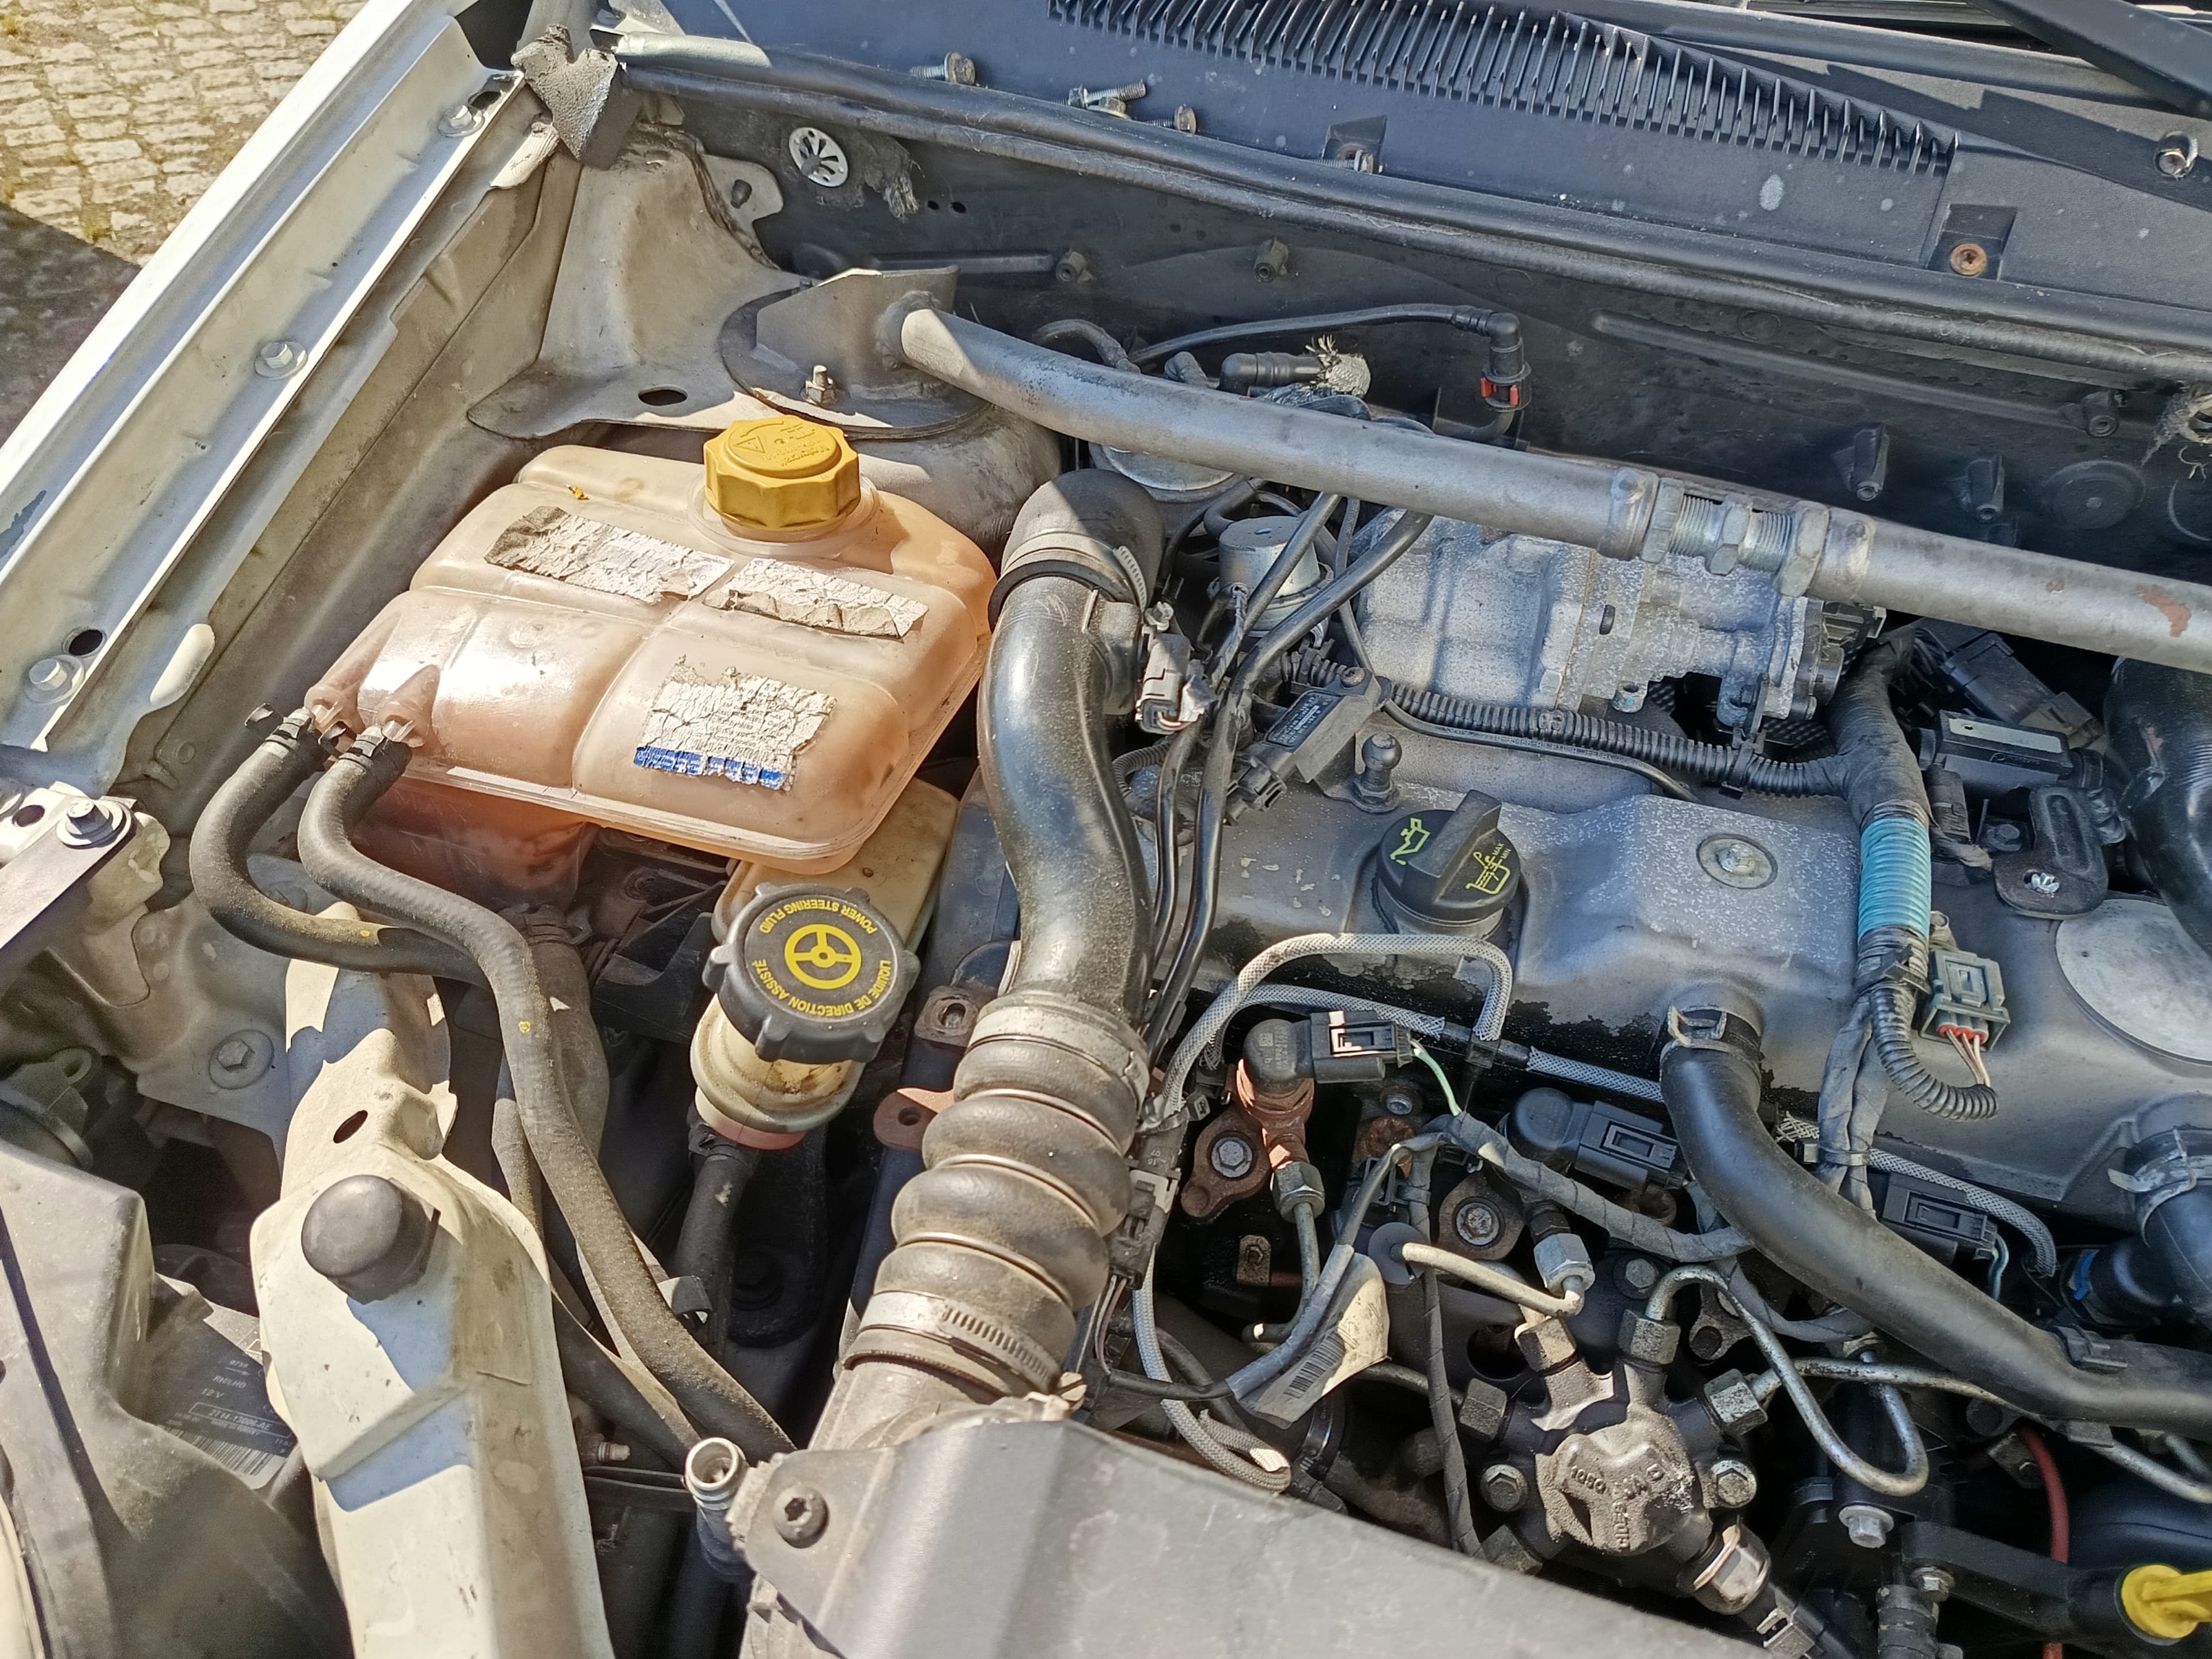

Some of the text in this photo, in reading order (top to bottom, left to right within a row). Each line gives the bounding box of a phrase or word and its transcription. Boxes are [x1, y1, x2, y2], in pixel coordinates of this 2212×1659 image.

[1492, 842, 1505, 856] MAX
[1500, 848, 1512, 859] MIN
[759, 899, 877, 934] POWER STEERING FLUID
[751, 958, 891, 1017] LIQUIDE DE DIRECTION ASSISTÉ
